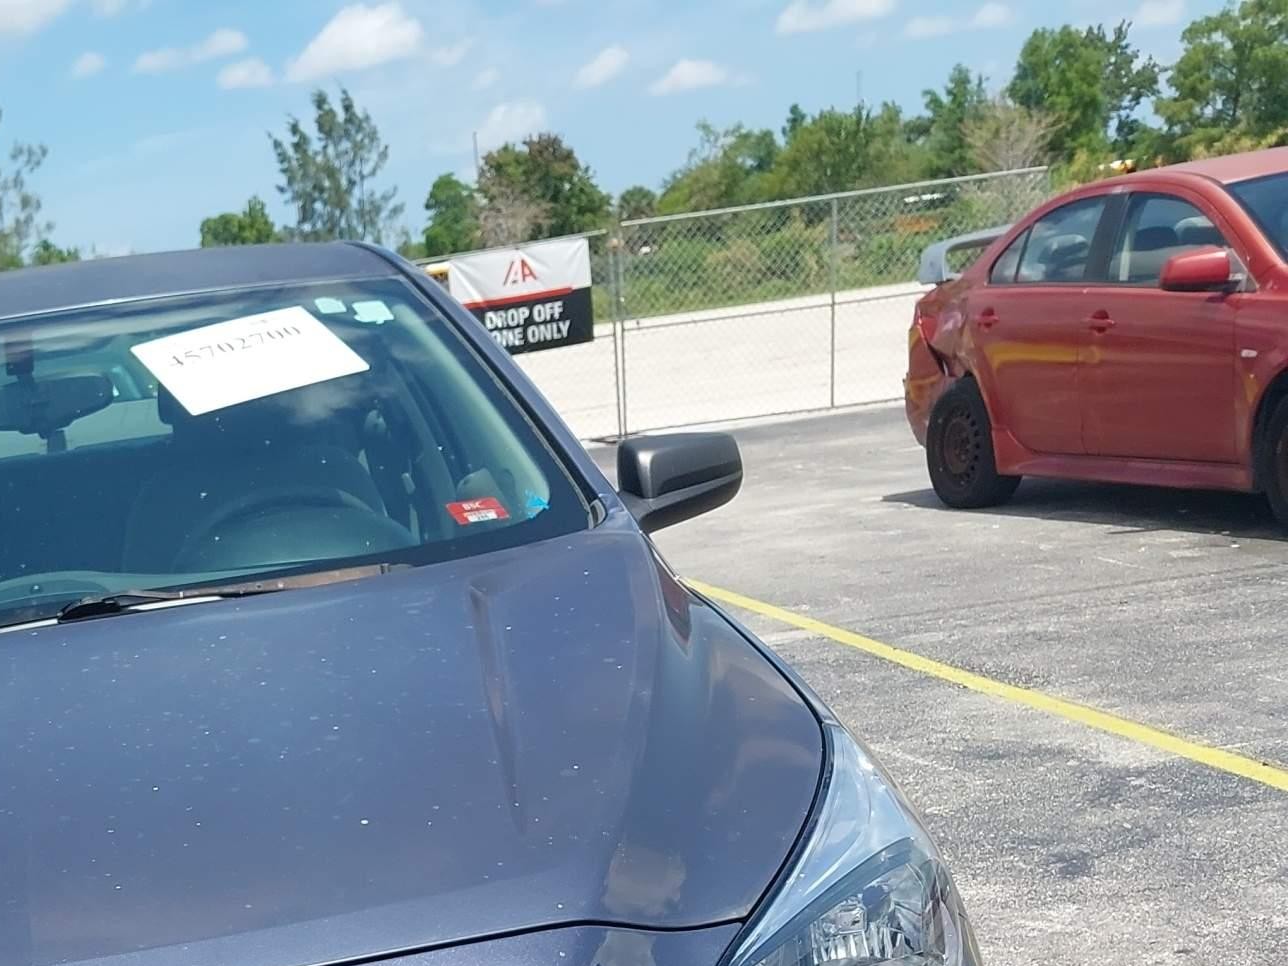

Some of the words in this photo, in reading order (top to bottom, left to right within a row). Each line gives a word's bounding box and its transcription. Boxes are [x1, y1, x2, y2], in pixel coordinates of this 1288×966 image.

[485, 306, 530, 330] DROP
[532, 300, 564, 323] OFF
[169, 325, 301, 367] 45702700
[526, 319, 571, 343] ONLY
